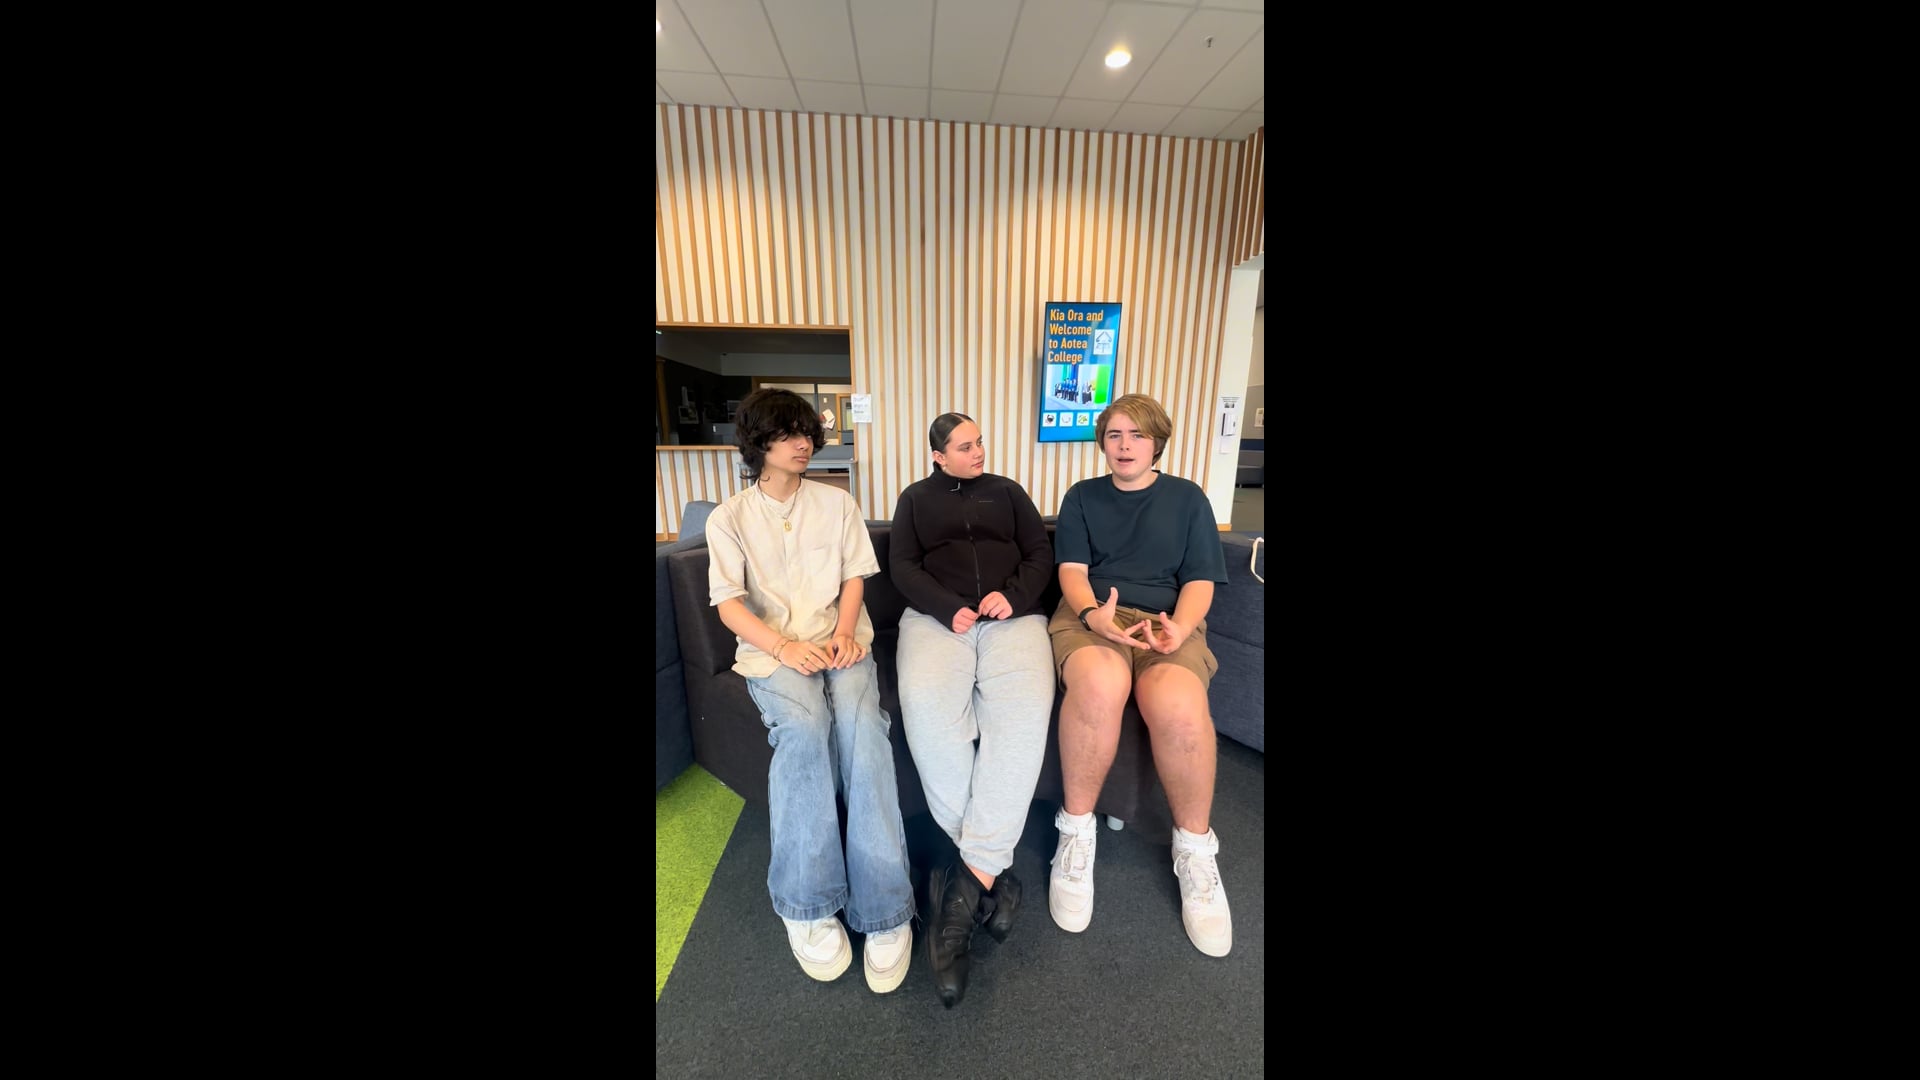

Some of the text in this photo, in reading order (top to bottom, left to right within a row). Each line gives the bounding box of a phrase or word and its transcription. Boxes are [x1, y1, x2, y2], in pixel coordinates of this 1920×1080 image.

[1050, 309, 1104, 321] Kia Ora and
[1049, 323, 1092, 335] Welcome
[1048, 338, 1088, 348] to Aotea
[1048, 352, 1082, 364] College
